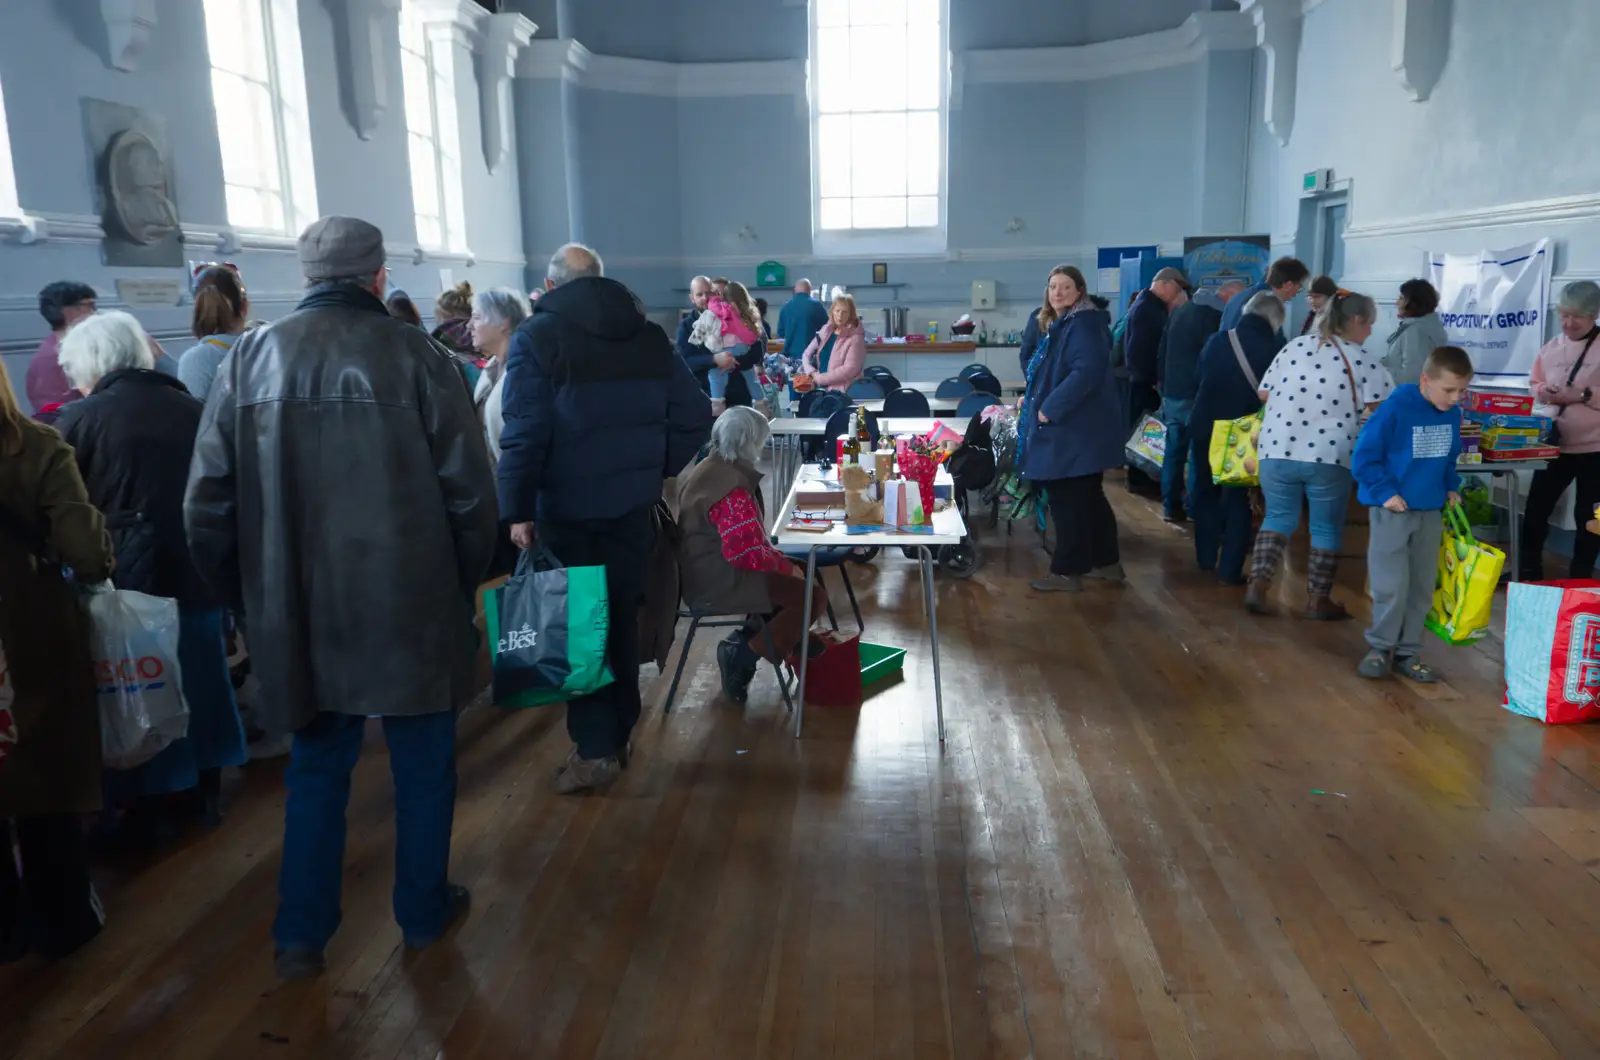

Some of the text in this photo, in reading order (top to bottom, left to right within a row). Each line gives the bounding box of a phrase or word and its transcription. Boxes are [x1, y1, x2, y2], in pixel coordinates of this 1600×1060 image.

[1497, 310, 1538, 328] GROUP
[508, 630, 538, 651] Best
[92, 656, 163, 683] SCO
